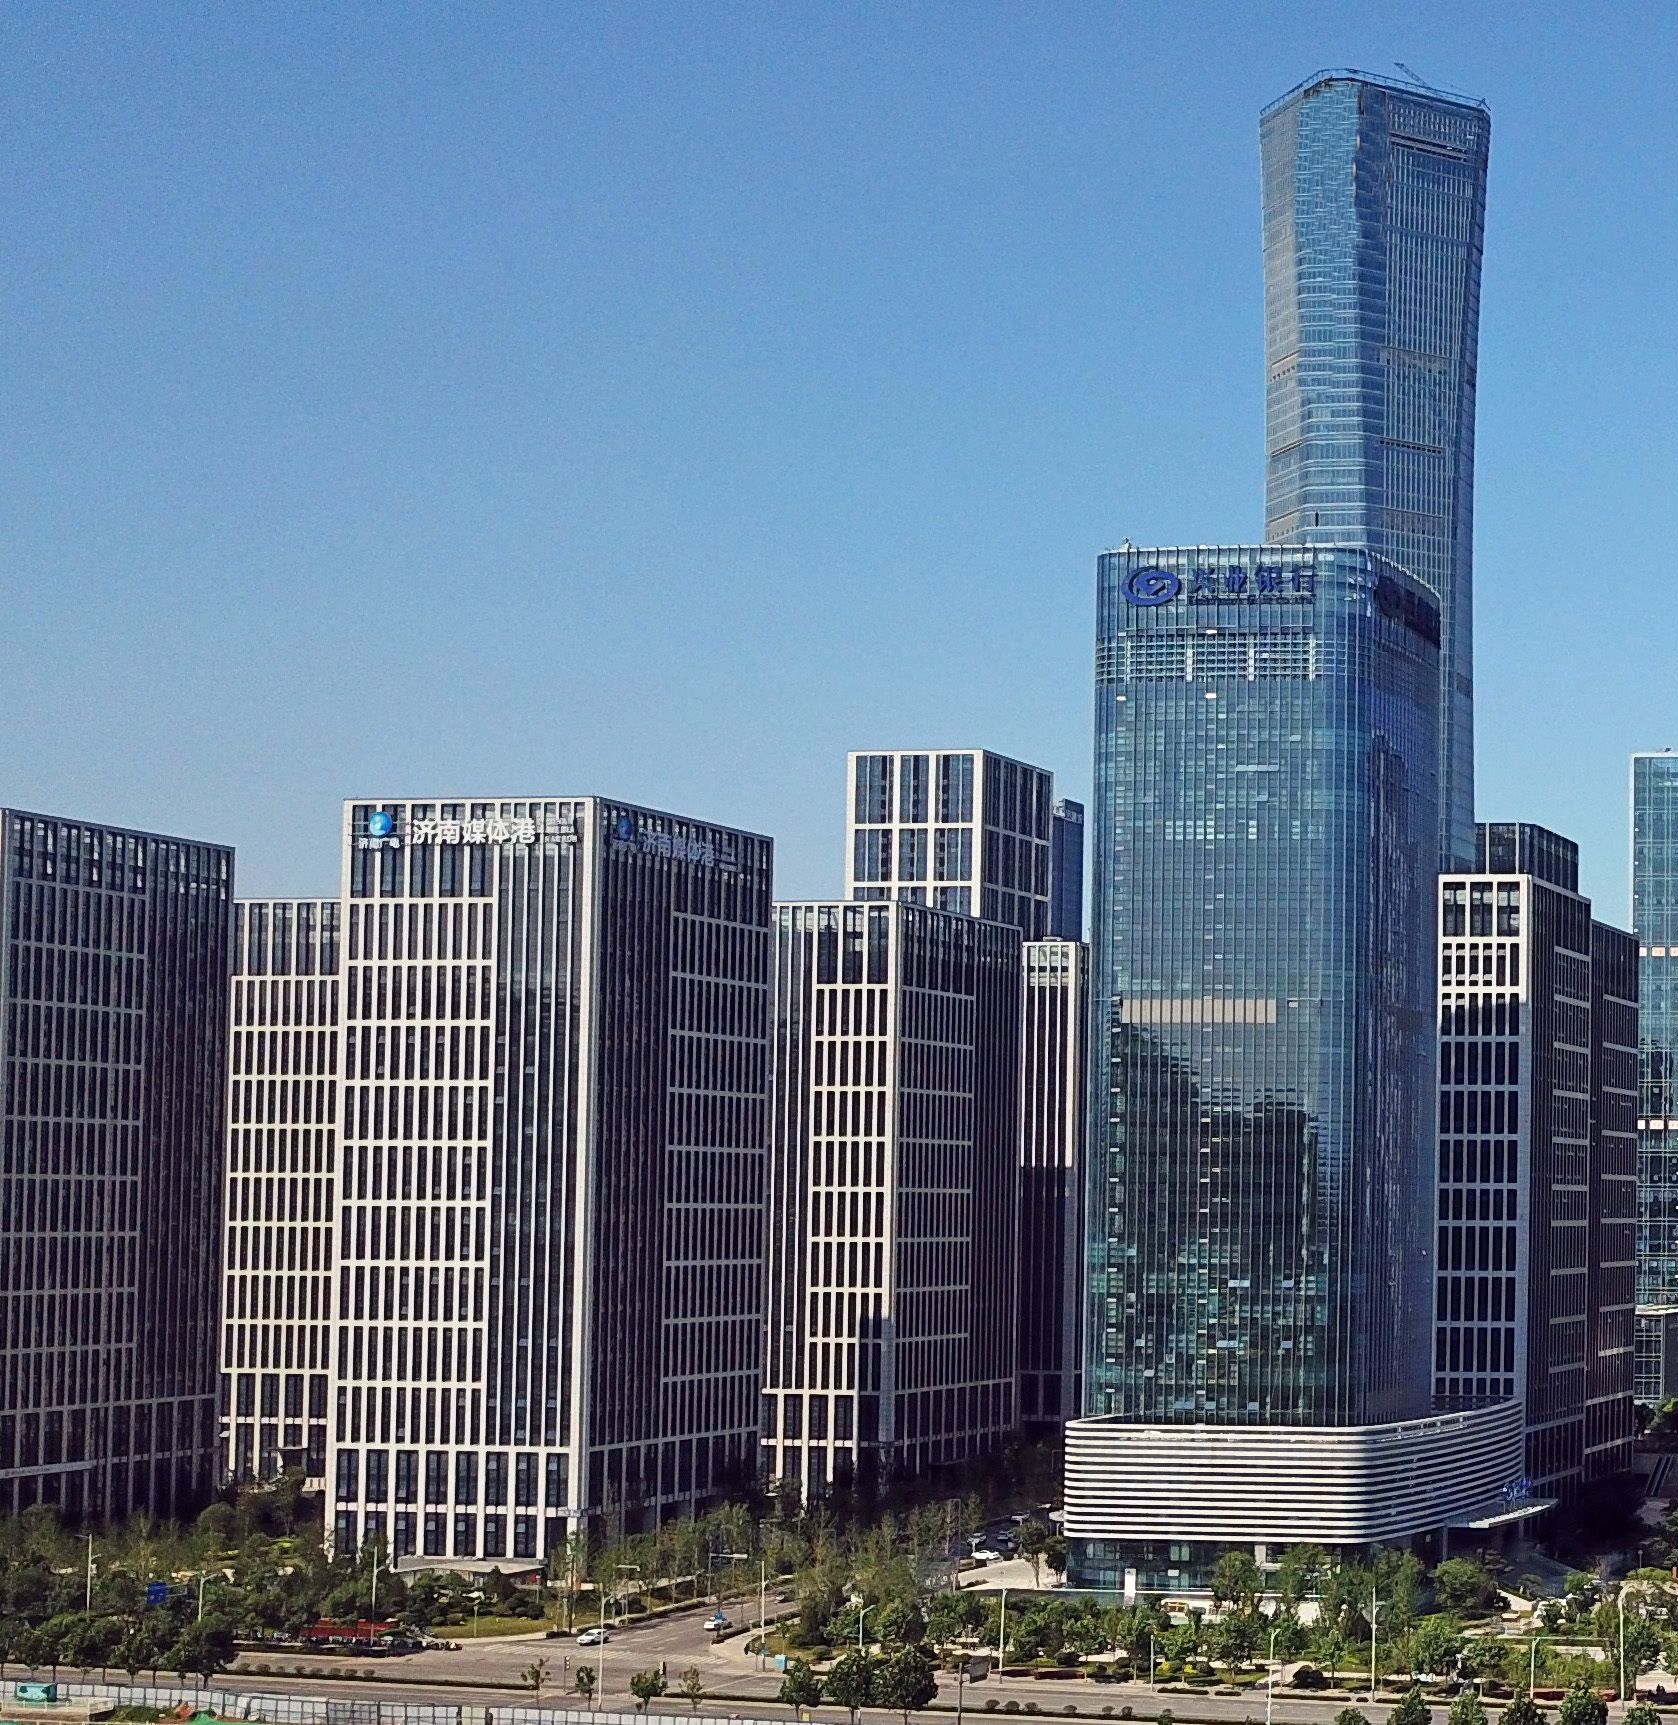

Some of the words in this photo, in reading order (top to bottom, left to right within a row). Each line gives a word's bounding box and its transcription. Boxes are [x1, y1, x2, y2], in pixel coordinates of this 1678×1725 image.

[412, 816, 535, 845] 济南媒体港
